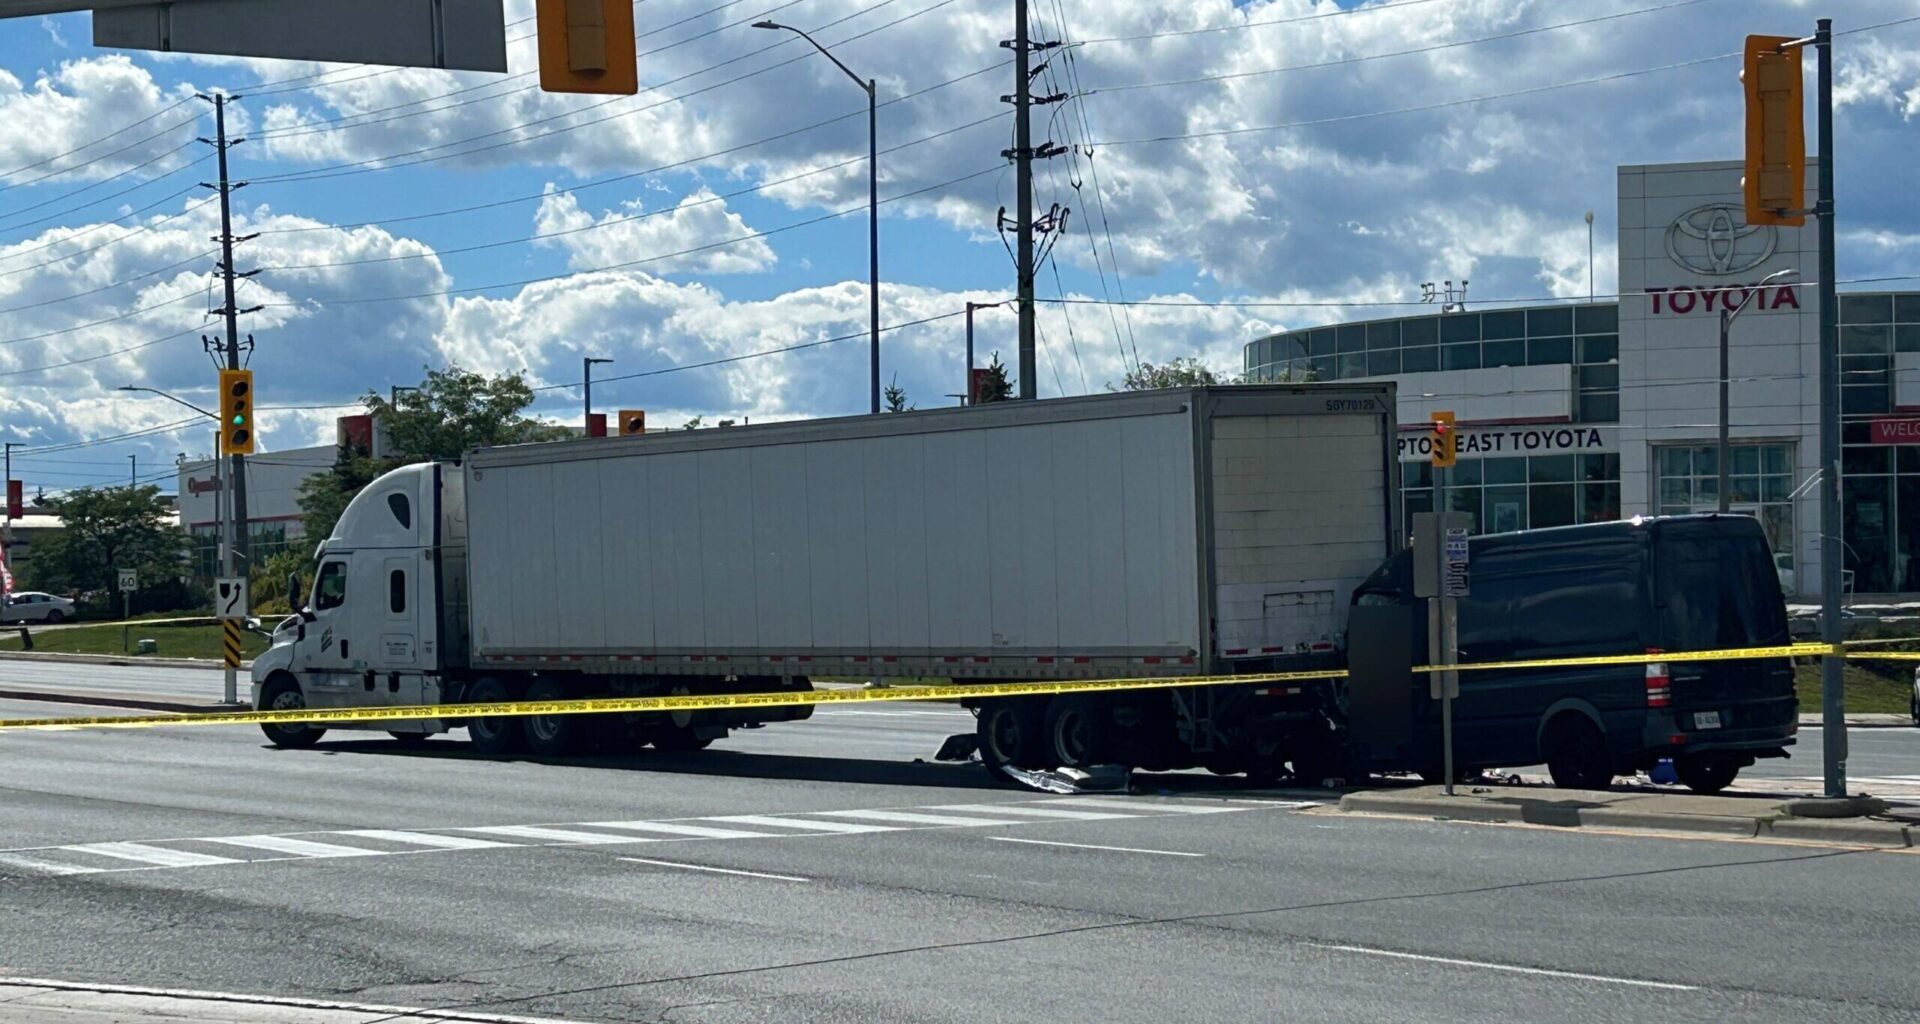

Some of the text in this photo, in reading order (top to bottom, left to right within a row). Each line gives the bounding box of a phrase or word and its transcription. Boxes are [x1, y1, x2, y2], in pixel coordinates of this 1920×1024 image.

[1644, 282, 1800, 314] TOYOTA
[1455, 432, 1505, 453] EAST
[1510, 428, 1603, 450] TOYOTA
[121, 577, 135, 587] 60
